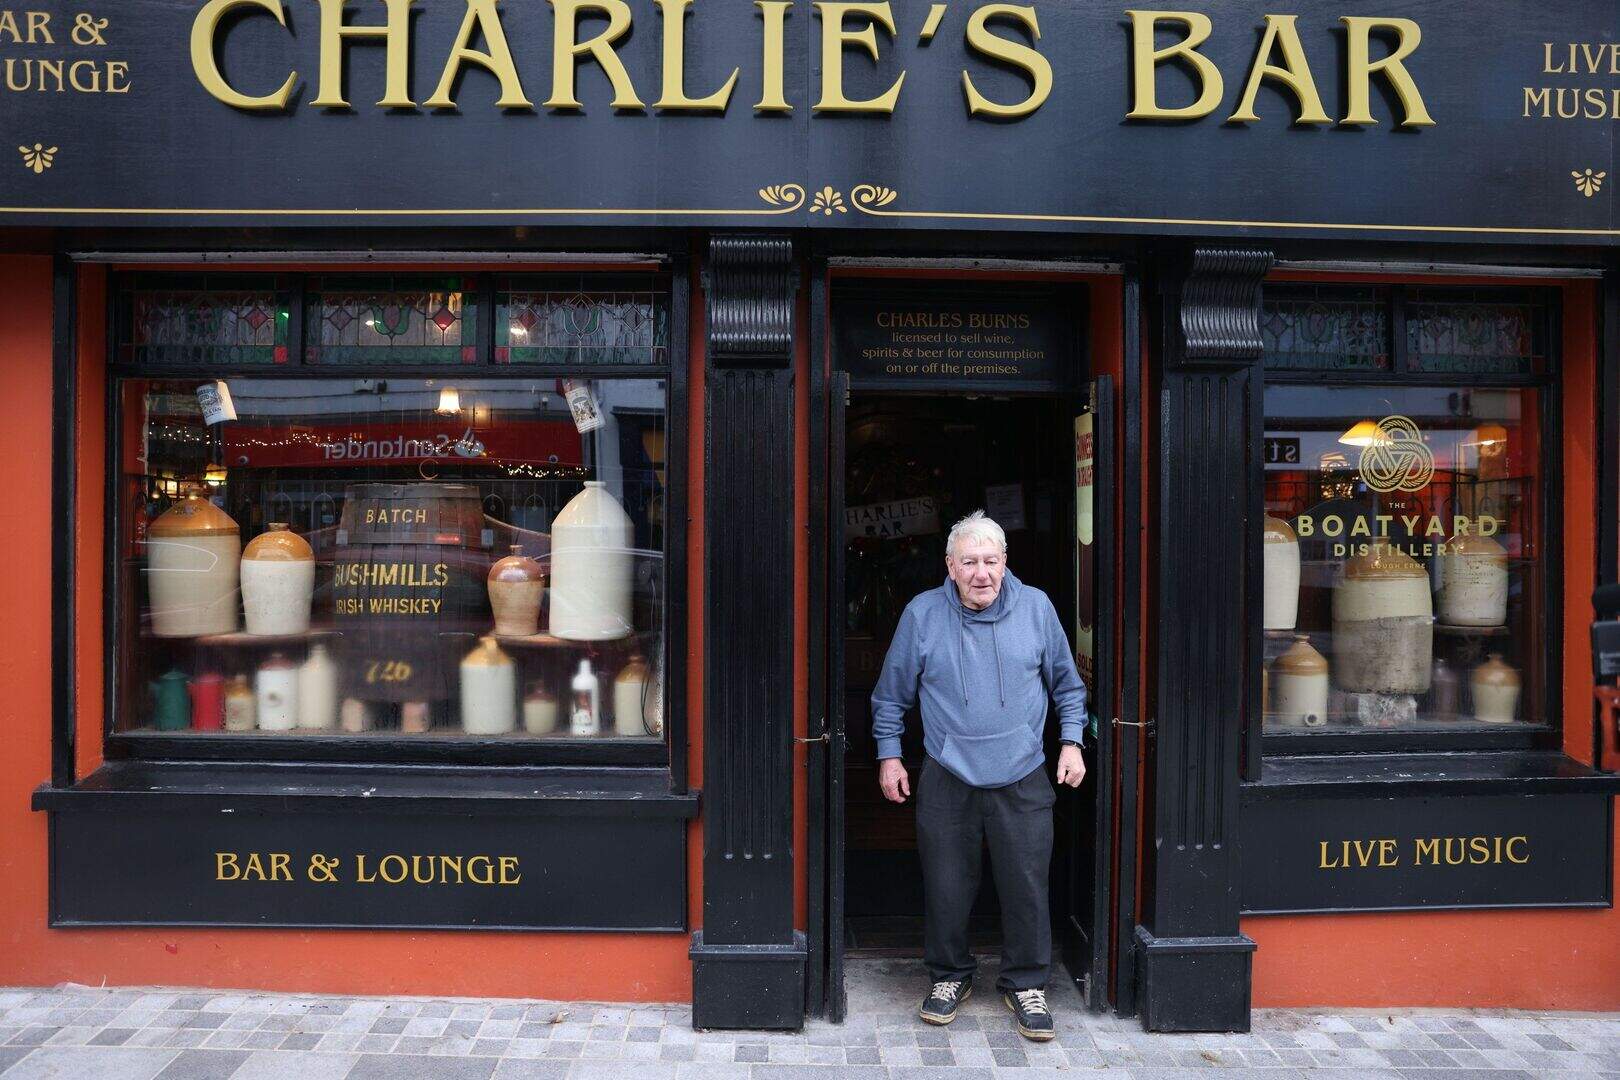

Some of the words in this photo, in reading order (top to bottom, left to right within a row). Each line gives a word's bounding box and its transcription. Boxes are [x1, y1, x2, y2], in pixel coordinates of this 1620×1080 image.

[71, 13, 109, 45] &
[190, 0, 1054, 117] CHARLIE'S
[1124, 10, 1437, 127] BAR
[877, 313, 962, 328] CHARLES
[969, 314, 1030, 329] BURNS
[892, 333, 941, 343] licensed
[945, 334, 957, 343] to
[960, 333, 980, 344] sell
[862, 348, 899, 359] spirits
[902, 348, 914, 358] &
[917, 347, 942, 358] beer
[948, 347, 964, 358] for
[967, 348, 1044, 361] consumption
[886, 364, 902, 374] on
[905, 364, 918, 374] or
[922, 363, 938, 374] off
[941, 363, 960, 374] the
[963, 364, 1021, 376] premises.
[366, 508, 427, 524] BATCH
[1297, 515, 1498, 537] BOATYARD
[1333, 543, 1462, 557] DISTILLERY
[335, 563, 449, 587] BUSHMILLS
[336, 598, 364, 614] IRISH
[369, 598, 441, 614] WHISKEY
[1318, 839, 1400, 868] LIVE
[1414, 836, 1530, 865] MUSIC
[215, 852, 295, 881] BAR
[308, 853, 339, 882] &
[356, 854, 522, 885] LOUNGE
